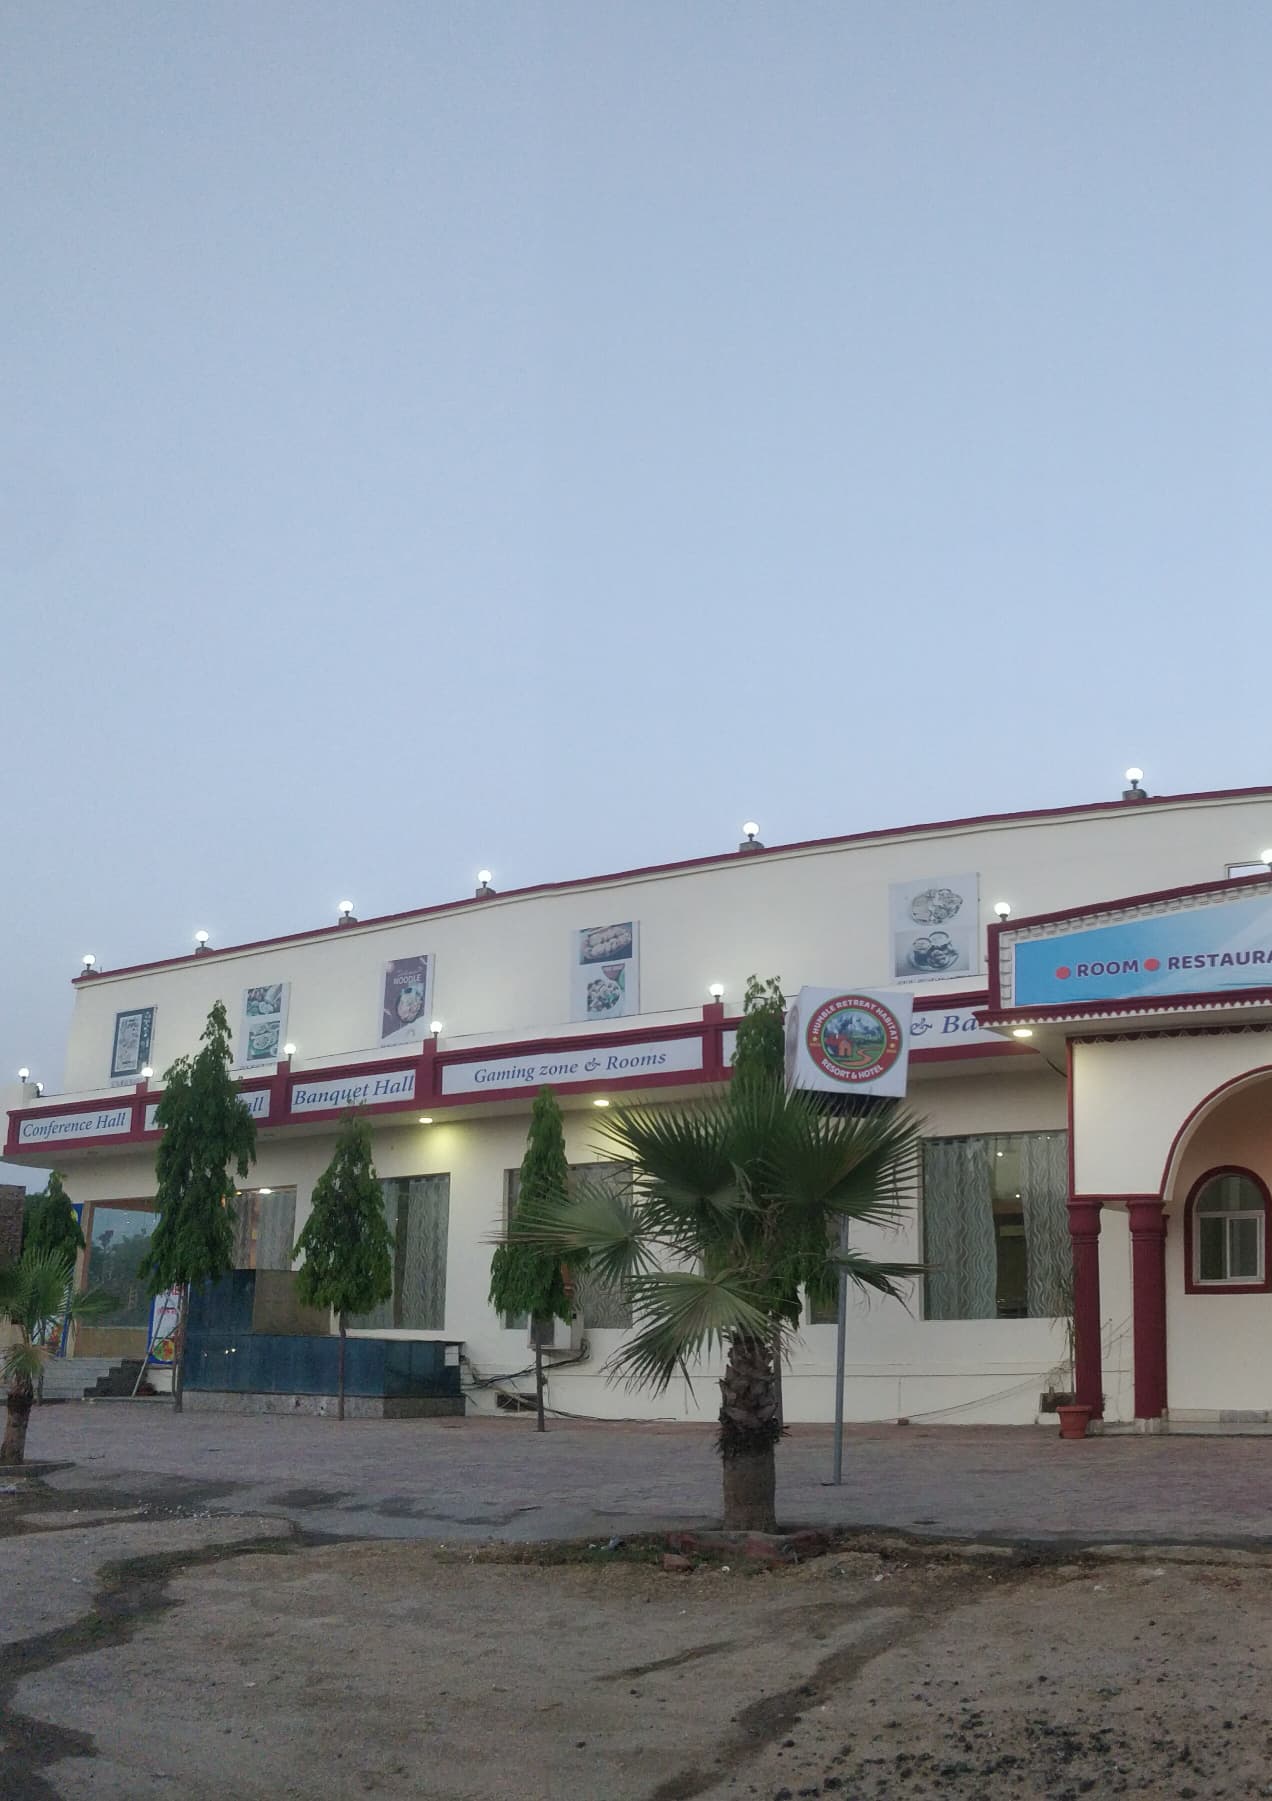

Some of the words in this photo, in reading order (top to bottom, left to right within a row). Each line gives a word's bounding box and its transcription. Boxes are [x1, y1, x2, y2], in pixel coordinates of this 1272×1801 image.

[1076, 959, 1140, 978] ROOM
[812, 1005, 837, 1034] HUMBLE
[836, 999, 877, 1011] RETREAT
[876, 1008, 899, 1040] HABITAT
[909, 1017, 933, 1036] &
[474, 1065, 536, 1084] Gaming
[539, 1062, 577, 1076] zone
[584, 1057, 601, 1072] &
[606, 1051, 667, 1070] Rooms
[821, 1058, 850, 1078] RESORT
[858, 1065, 884, 1079] HOTEL
[294, 1083, 370, 1107] Banquet
[373, 1074, 415, 1096] Hall
[23, 1119, 92, 1139] Conference
[97, 1112, 126, 1130] Hall
